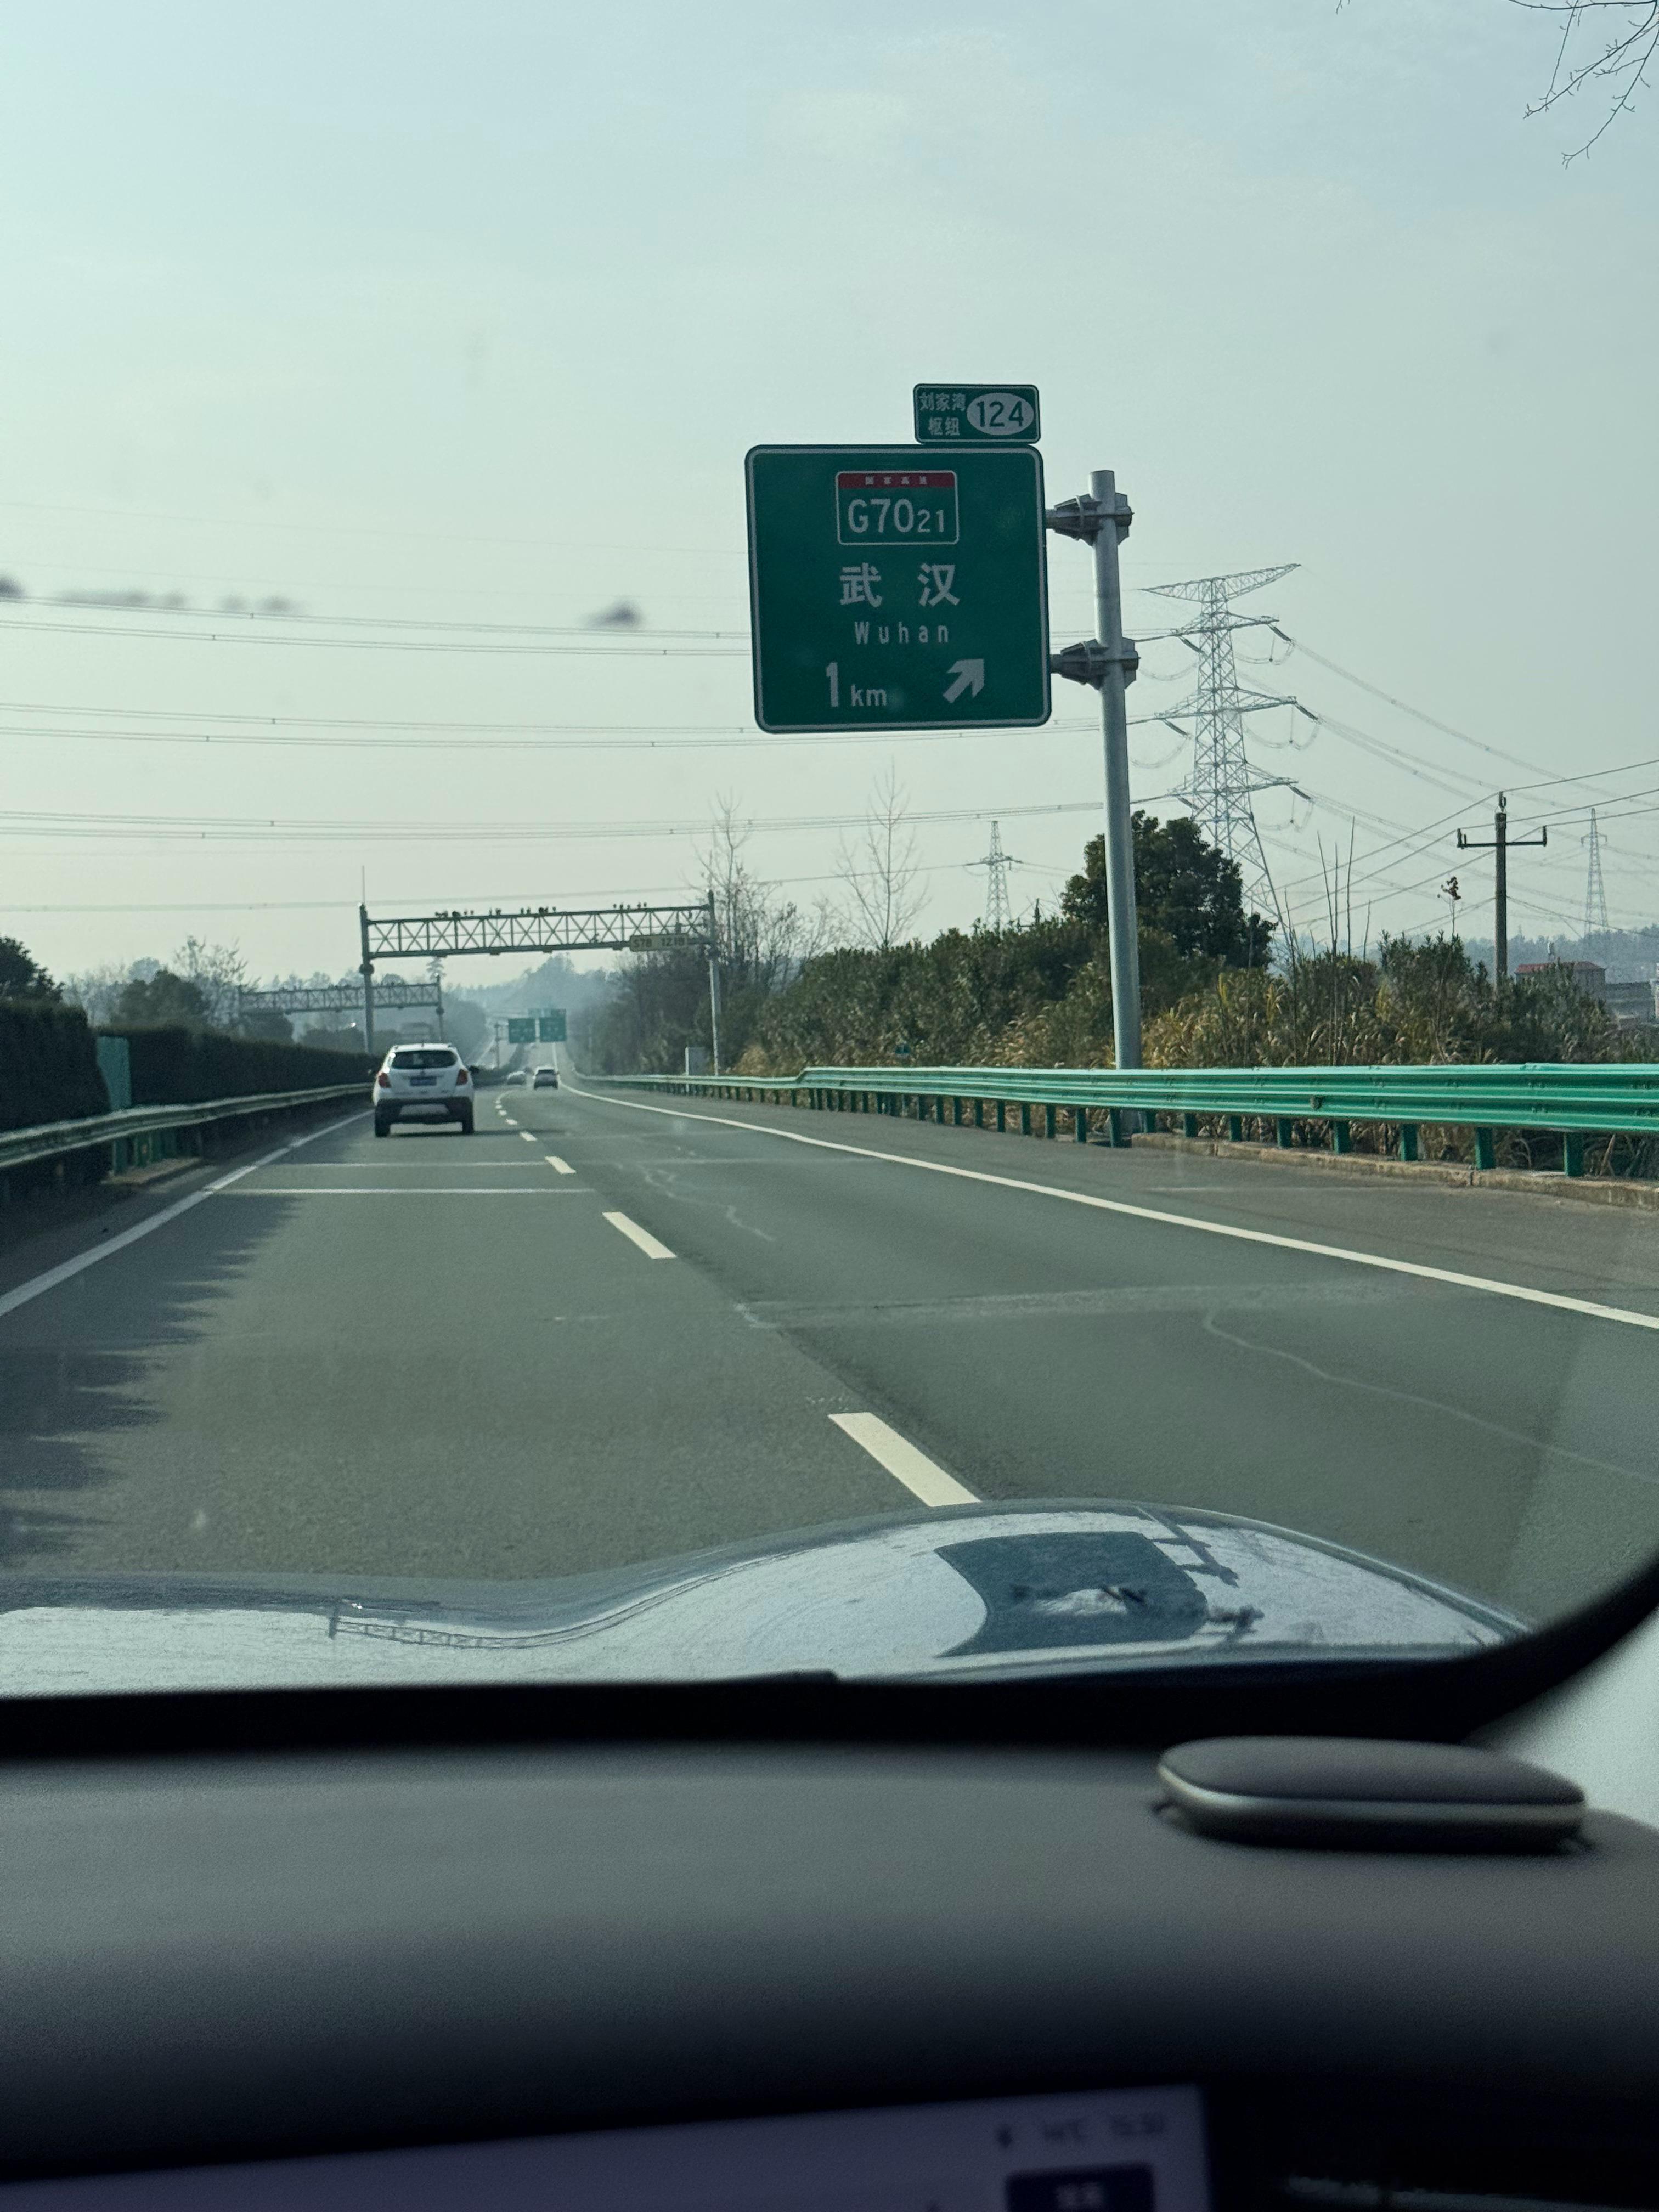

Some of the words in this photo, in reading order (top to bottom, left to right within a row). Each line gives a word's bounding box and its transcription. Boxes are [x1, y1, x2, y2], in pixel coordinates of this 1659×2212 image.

[928, 417, 960, 436] 枢纽
[976, 400, 1024, 427] 124
[848, 499, 945, 533] G7021
[839, 562, 960, 607] 武汉
[854, 621, 949, 645] Wuhan
[826, 662, 839, 707] 1
[851, 684, 887, 707] km
